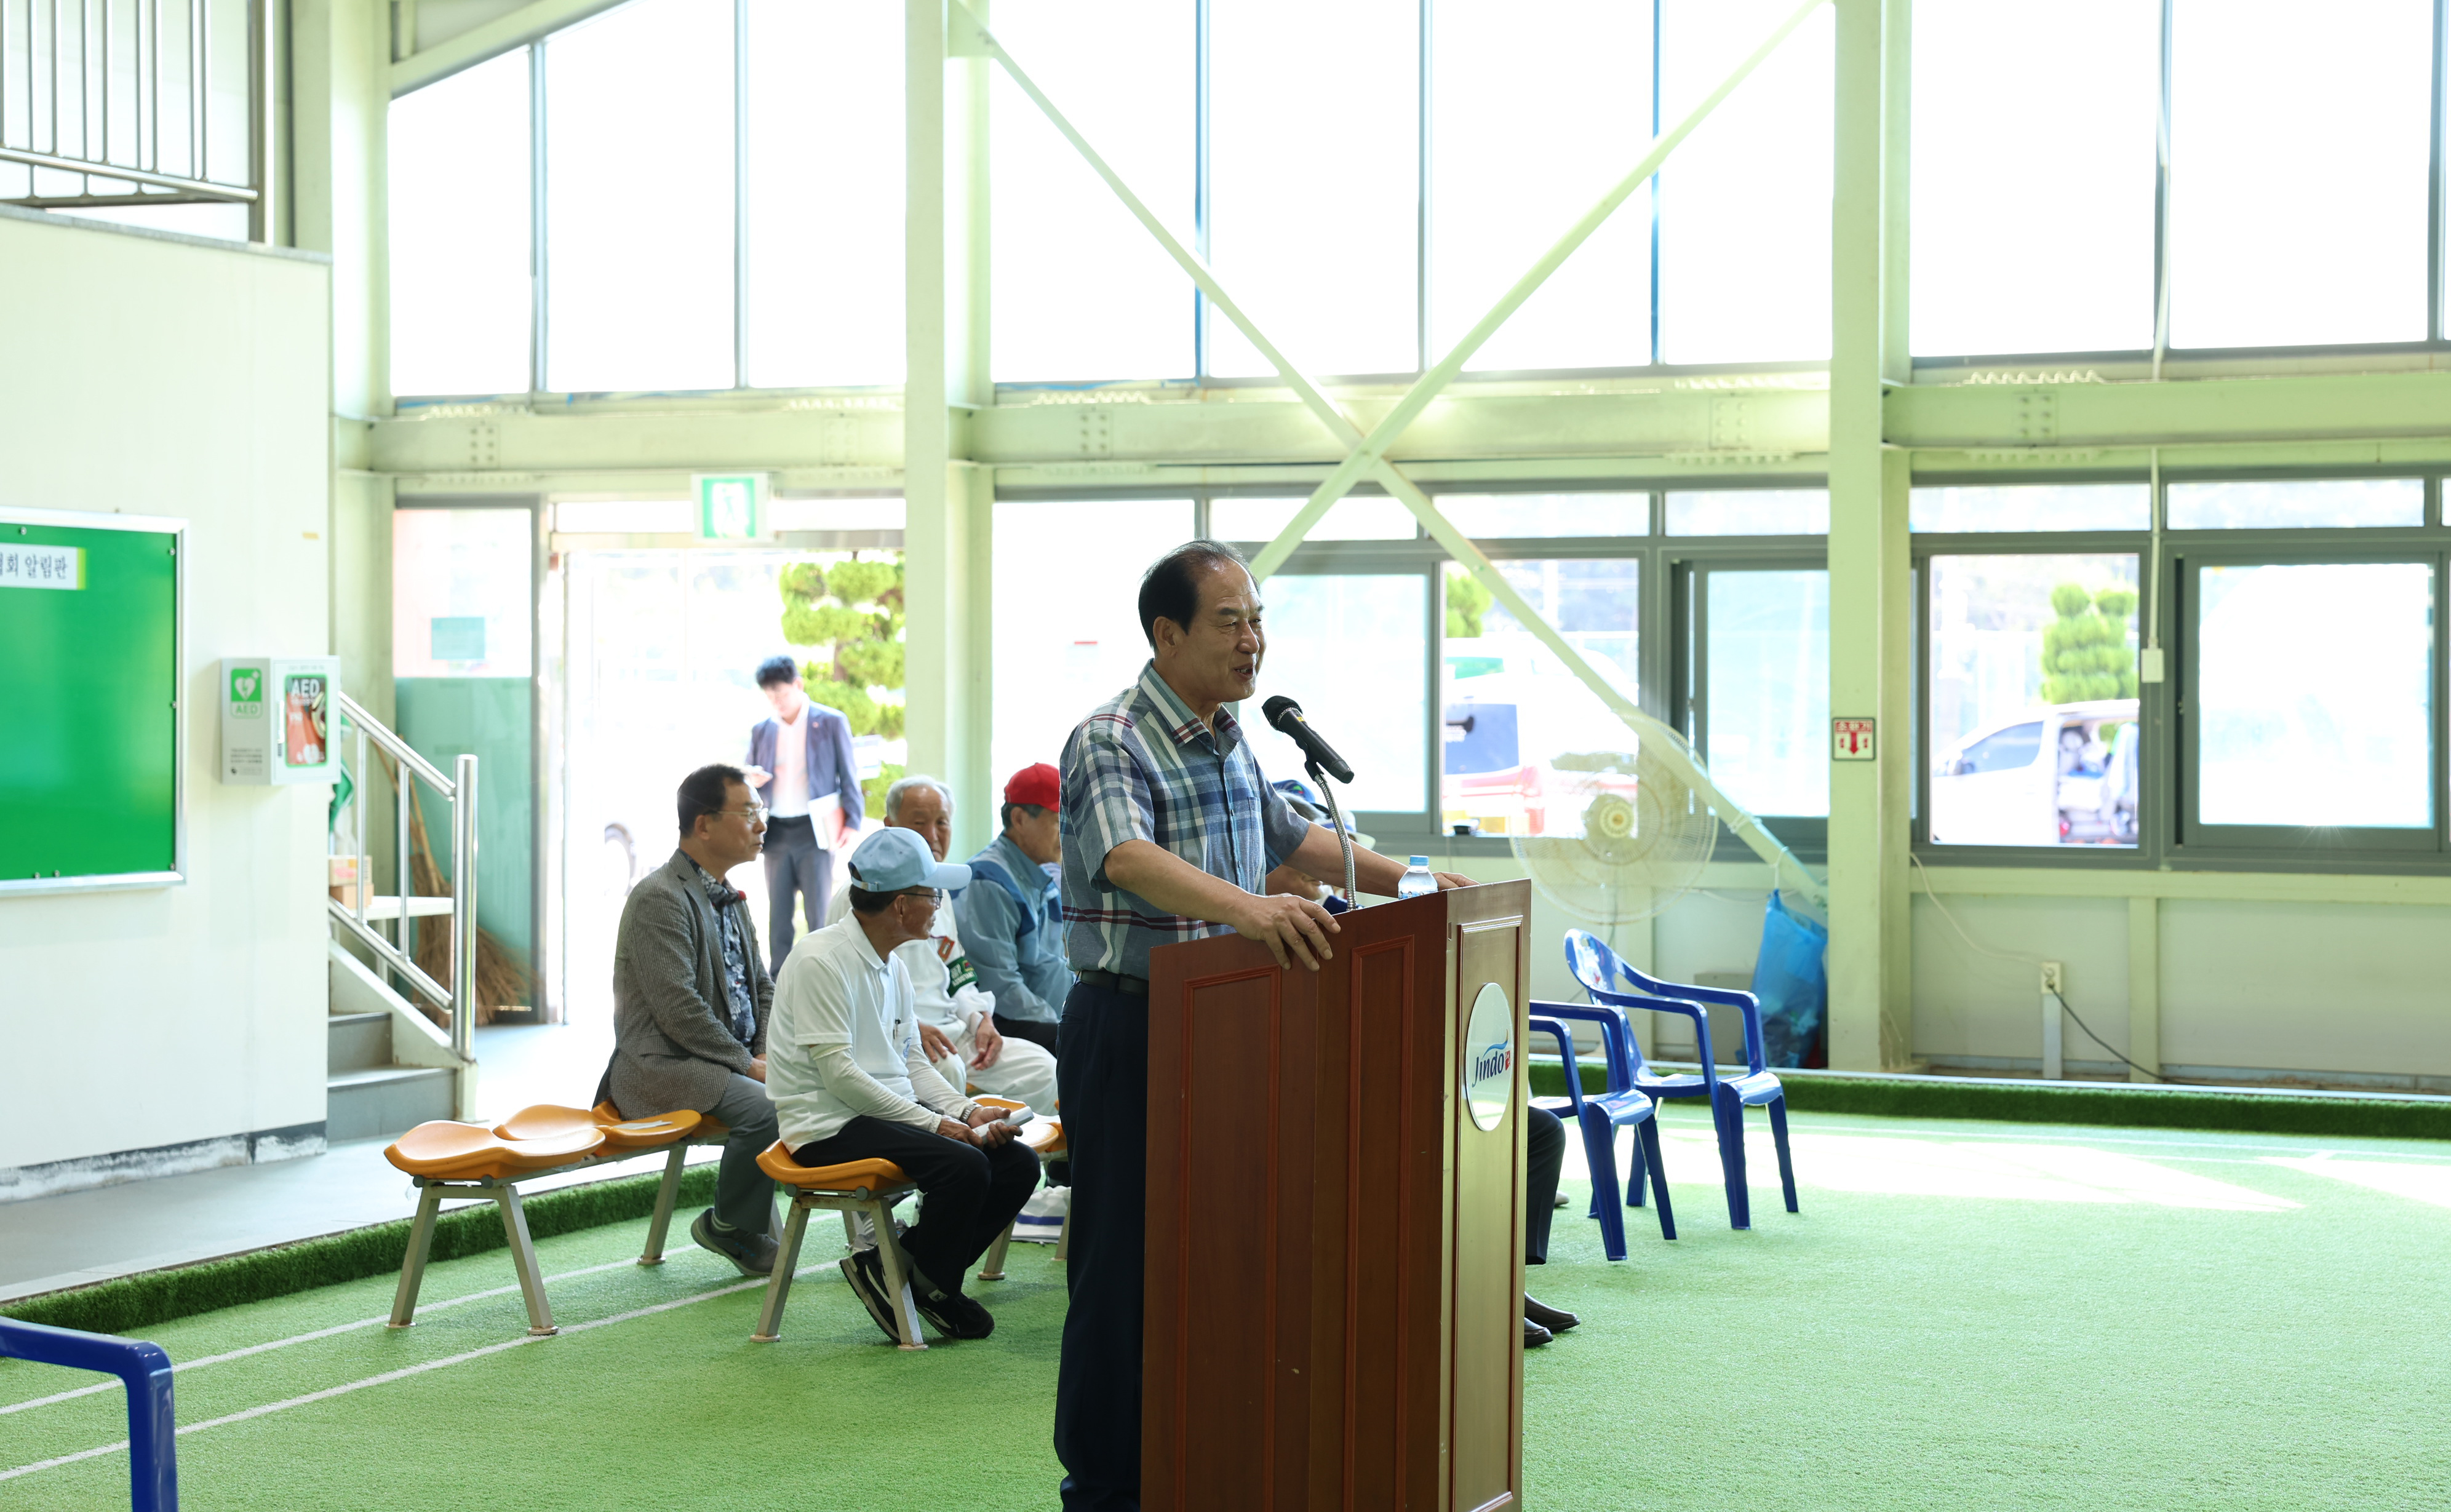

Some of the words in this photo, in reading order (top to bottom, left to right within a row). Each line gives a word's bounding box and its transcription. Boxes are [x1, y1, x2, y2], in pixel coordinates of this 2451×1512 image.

[25, 554, 68, 579] 알림판
[291, 679, 320, 698] AED
[236, 704, 258, 715] AED
[1837, 722, 1871, 732] 소화기
[1472, 1051, 1504, 1088] Jindo
